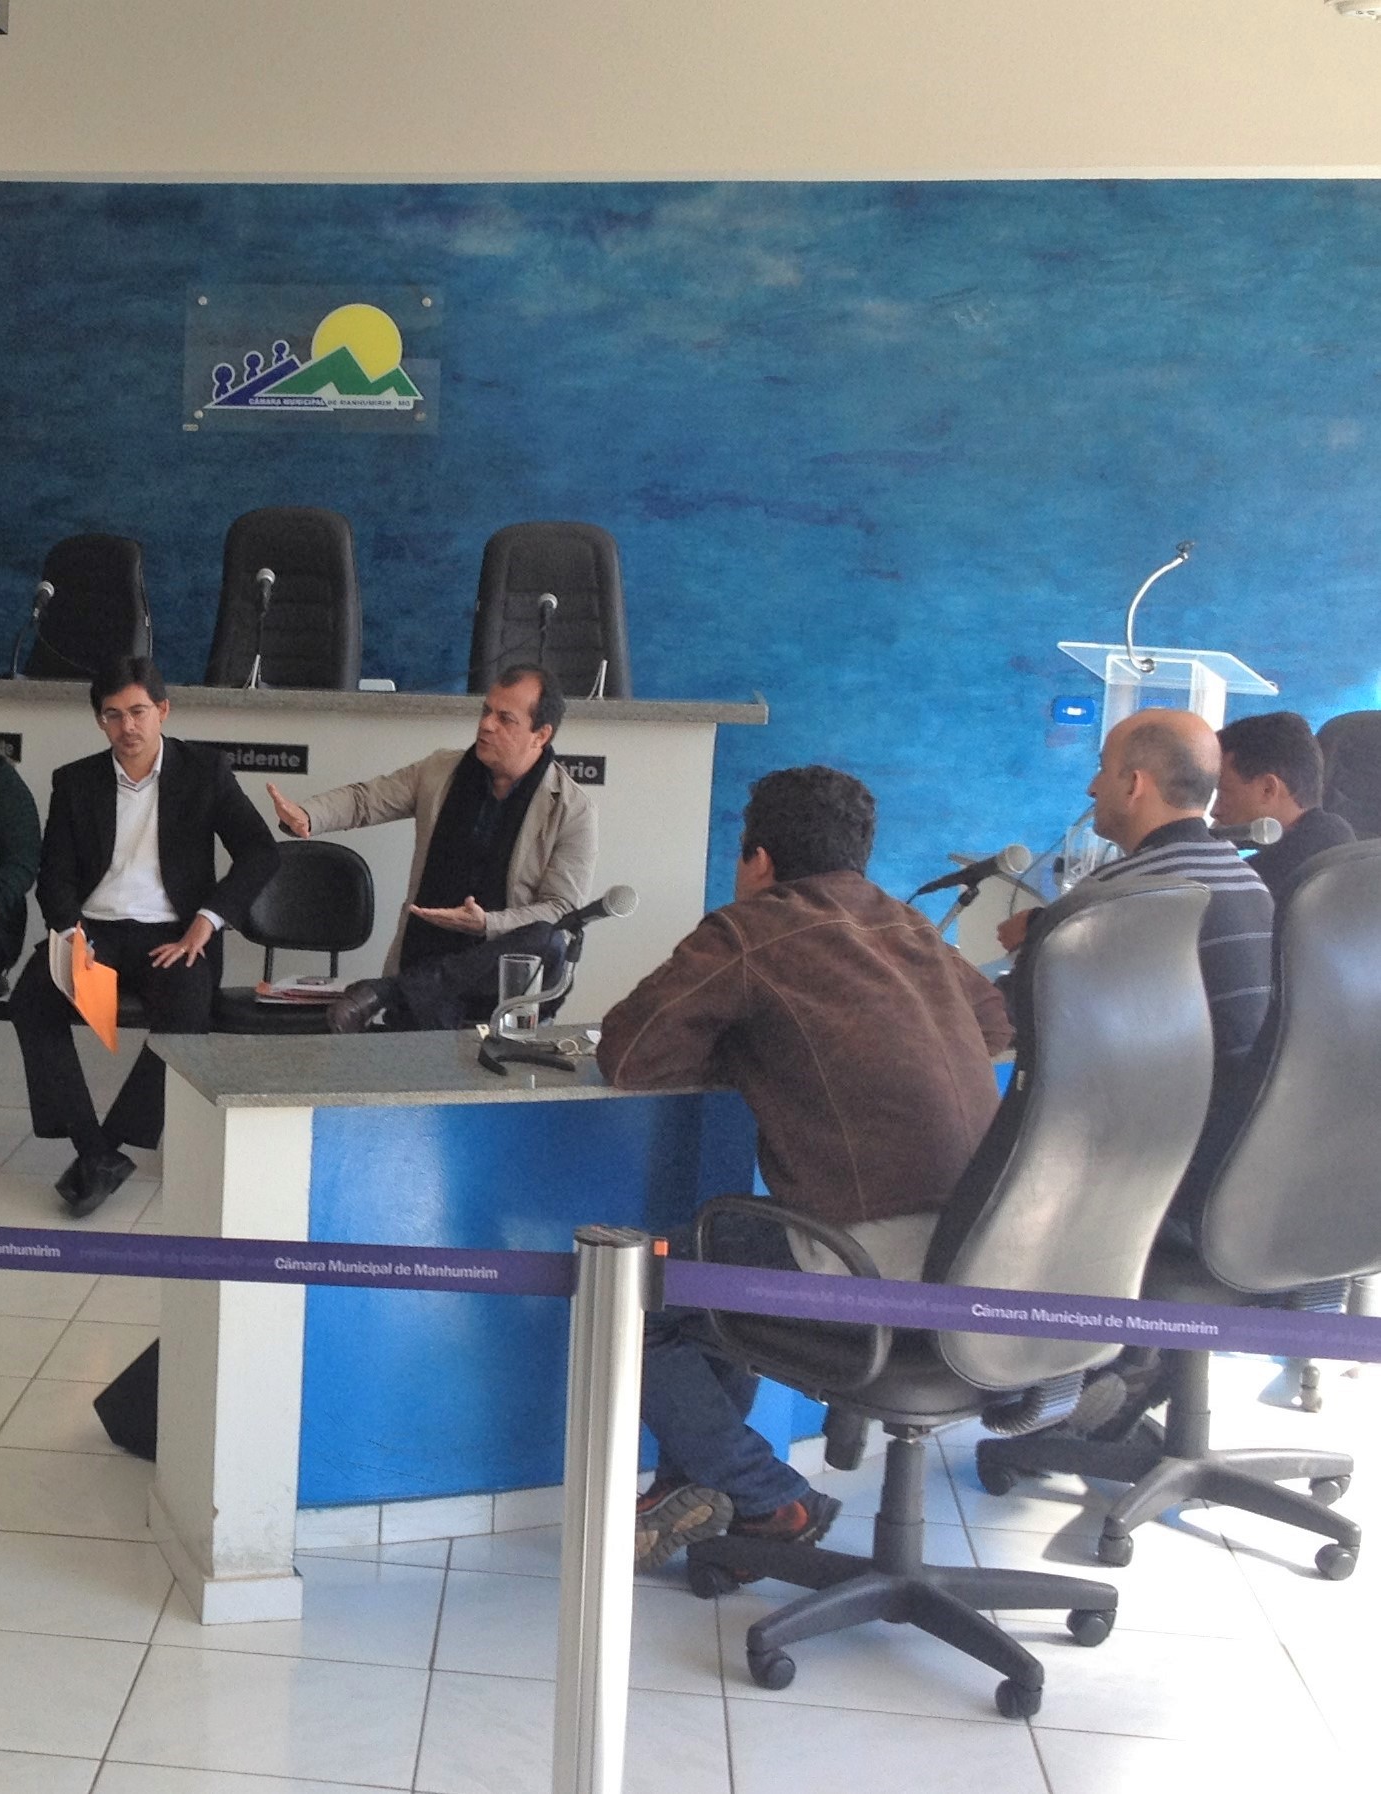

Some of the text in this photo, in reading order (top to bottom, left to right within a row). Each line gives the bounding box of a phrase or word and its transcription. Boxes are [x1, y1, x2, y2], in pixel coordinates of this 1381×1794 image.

[225, 748, 300, 768] sidente
[274, 1256, 326, 1272] Câmara
[328, 1259, 393, 1277] Municipal
[394, 1262, 412, 1276] de
[413, 1263, 499, 1280] Manhumirim
[971, 1303, 1219, 1335] Câmara Municipal de Manhumirim
